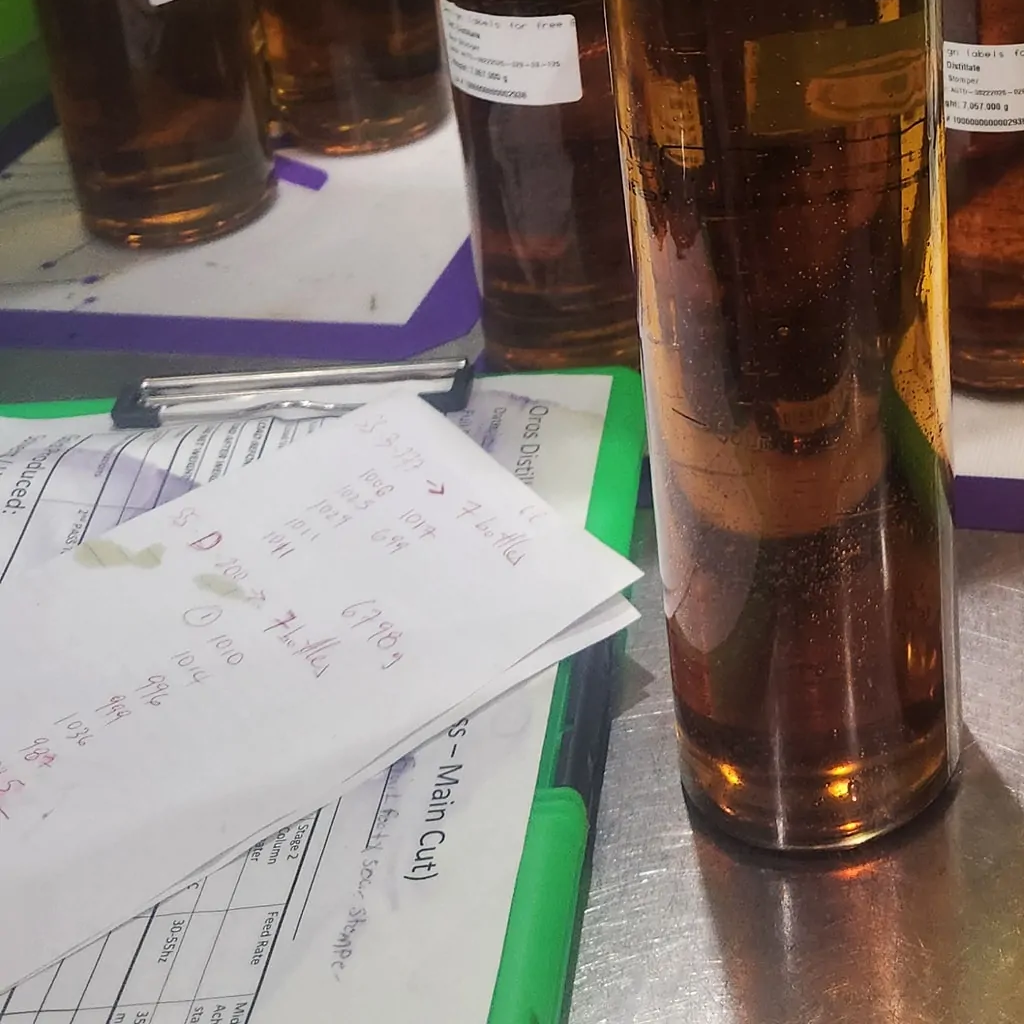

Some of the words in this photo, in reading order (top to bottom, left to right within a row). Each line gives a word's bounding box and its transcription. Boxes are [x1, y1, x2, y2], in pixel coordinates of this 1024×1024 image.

[946, 60, 981, 72] Distillate
[522, 404, 549, 440] Oros
[206, 633, 244, 666] 1010
[425, 763, 463, 823] Main
[289, 824, 309, 851] Stage
[286, 852, 299, 861] 2
[403, 830, 447, 881] Cut)
[261, 911, 278, 939] Feed
[158, 919, 185, 964] 30-55hz
[250, 940, 268, 966] Rate
